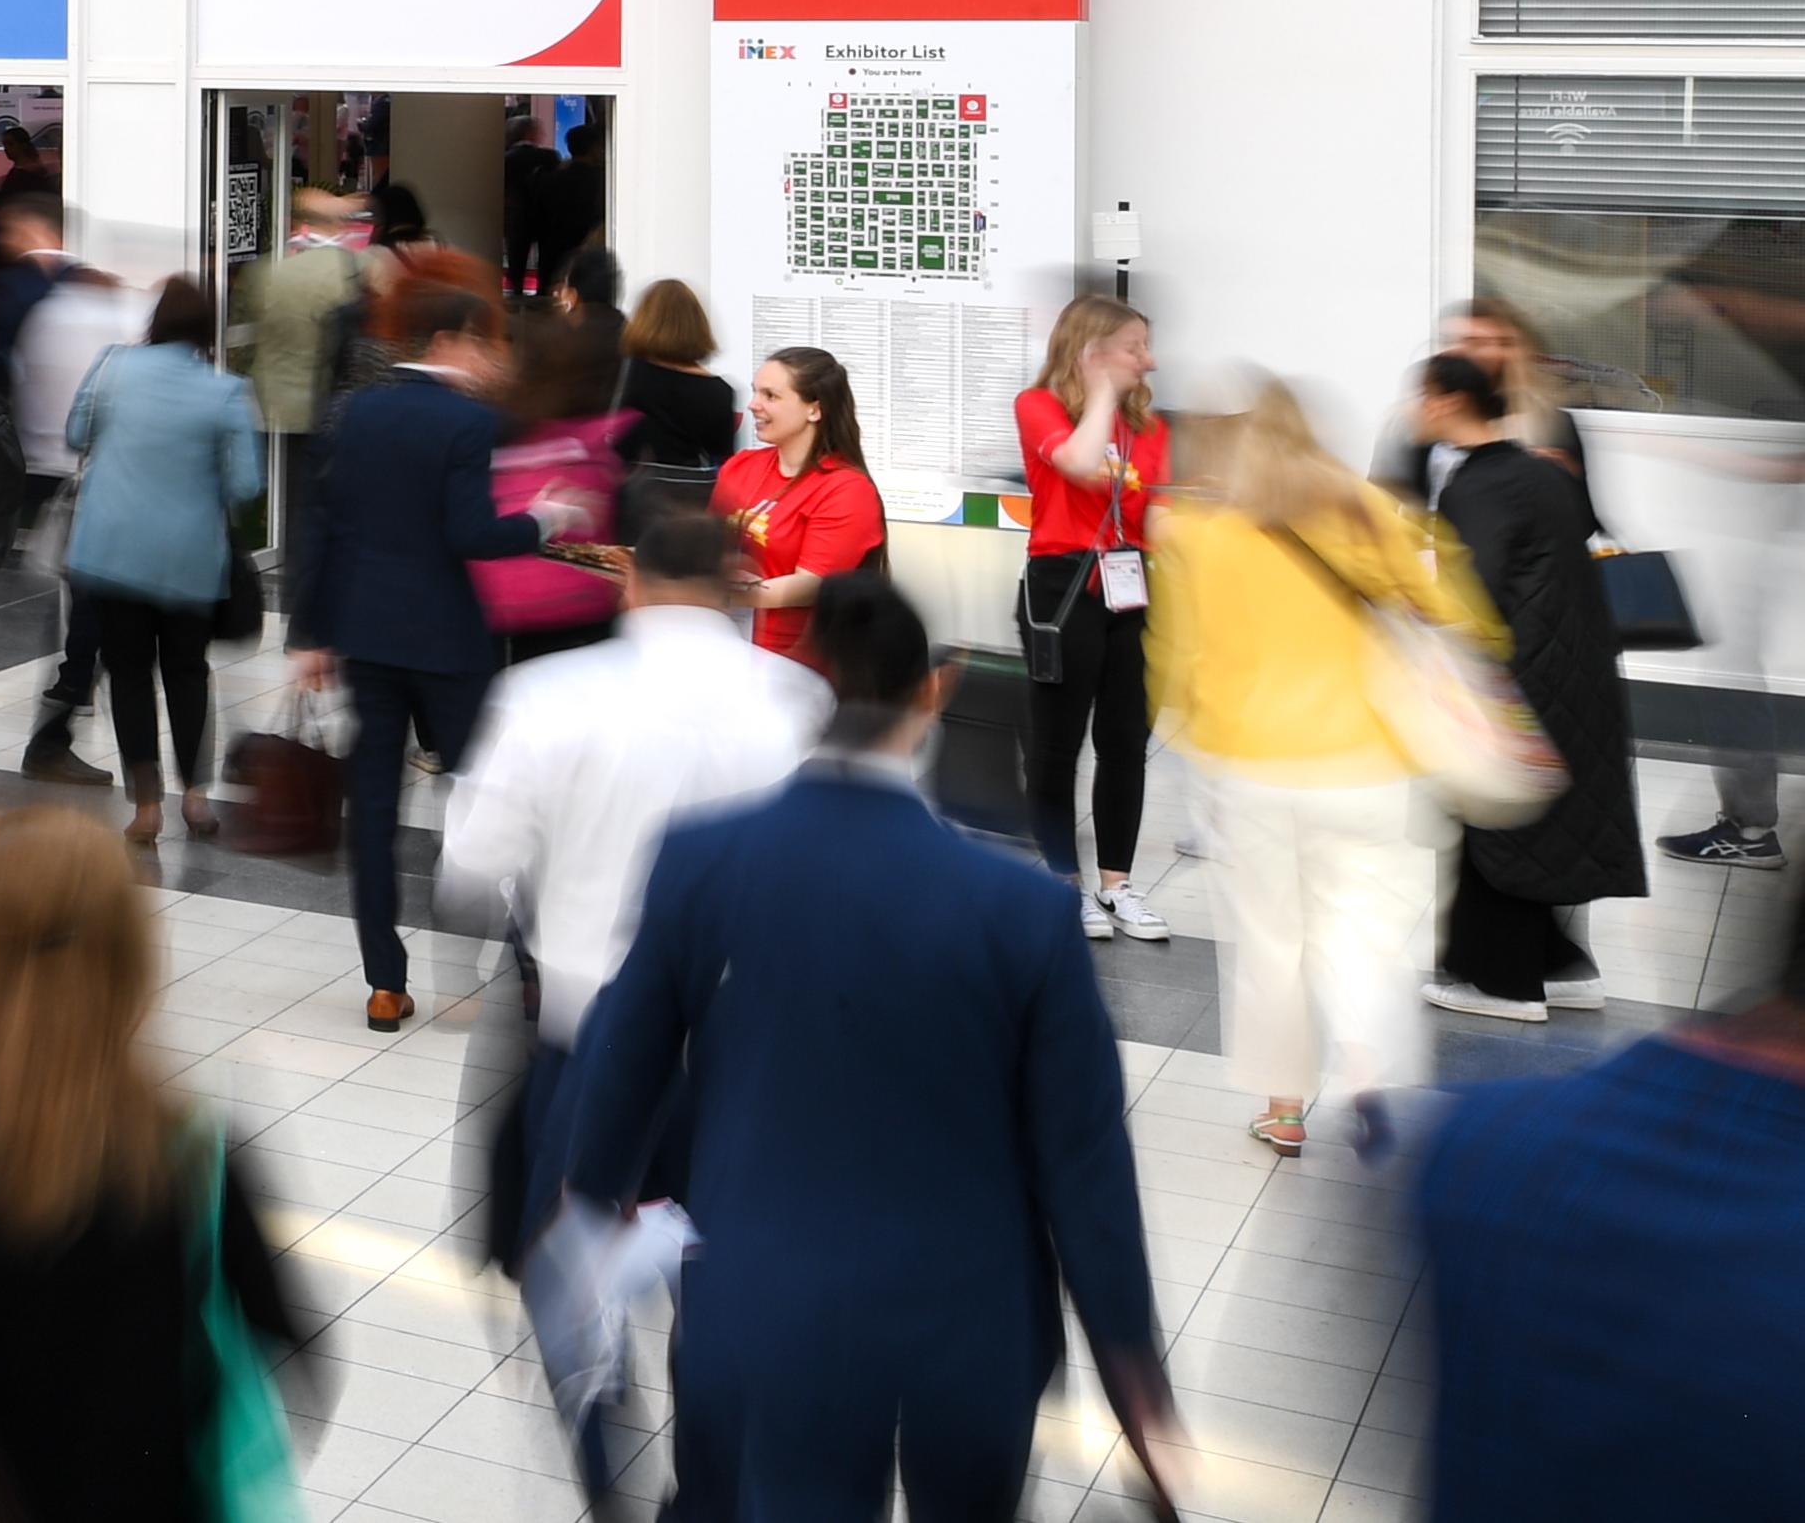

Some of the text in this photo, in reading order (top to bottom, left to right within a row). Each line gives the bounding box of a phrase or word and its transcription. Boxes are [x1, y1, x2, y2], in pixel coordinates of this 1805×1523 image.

[825, 44, 947, 60] Exhibitor List
[863, 68, 881, 77] You
[900, 68, 923, 77] here
